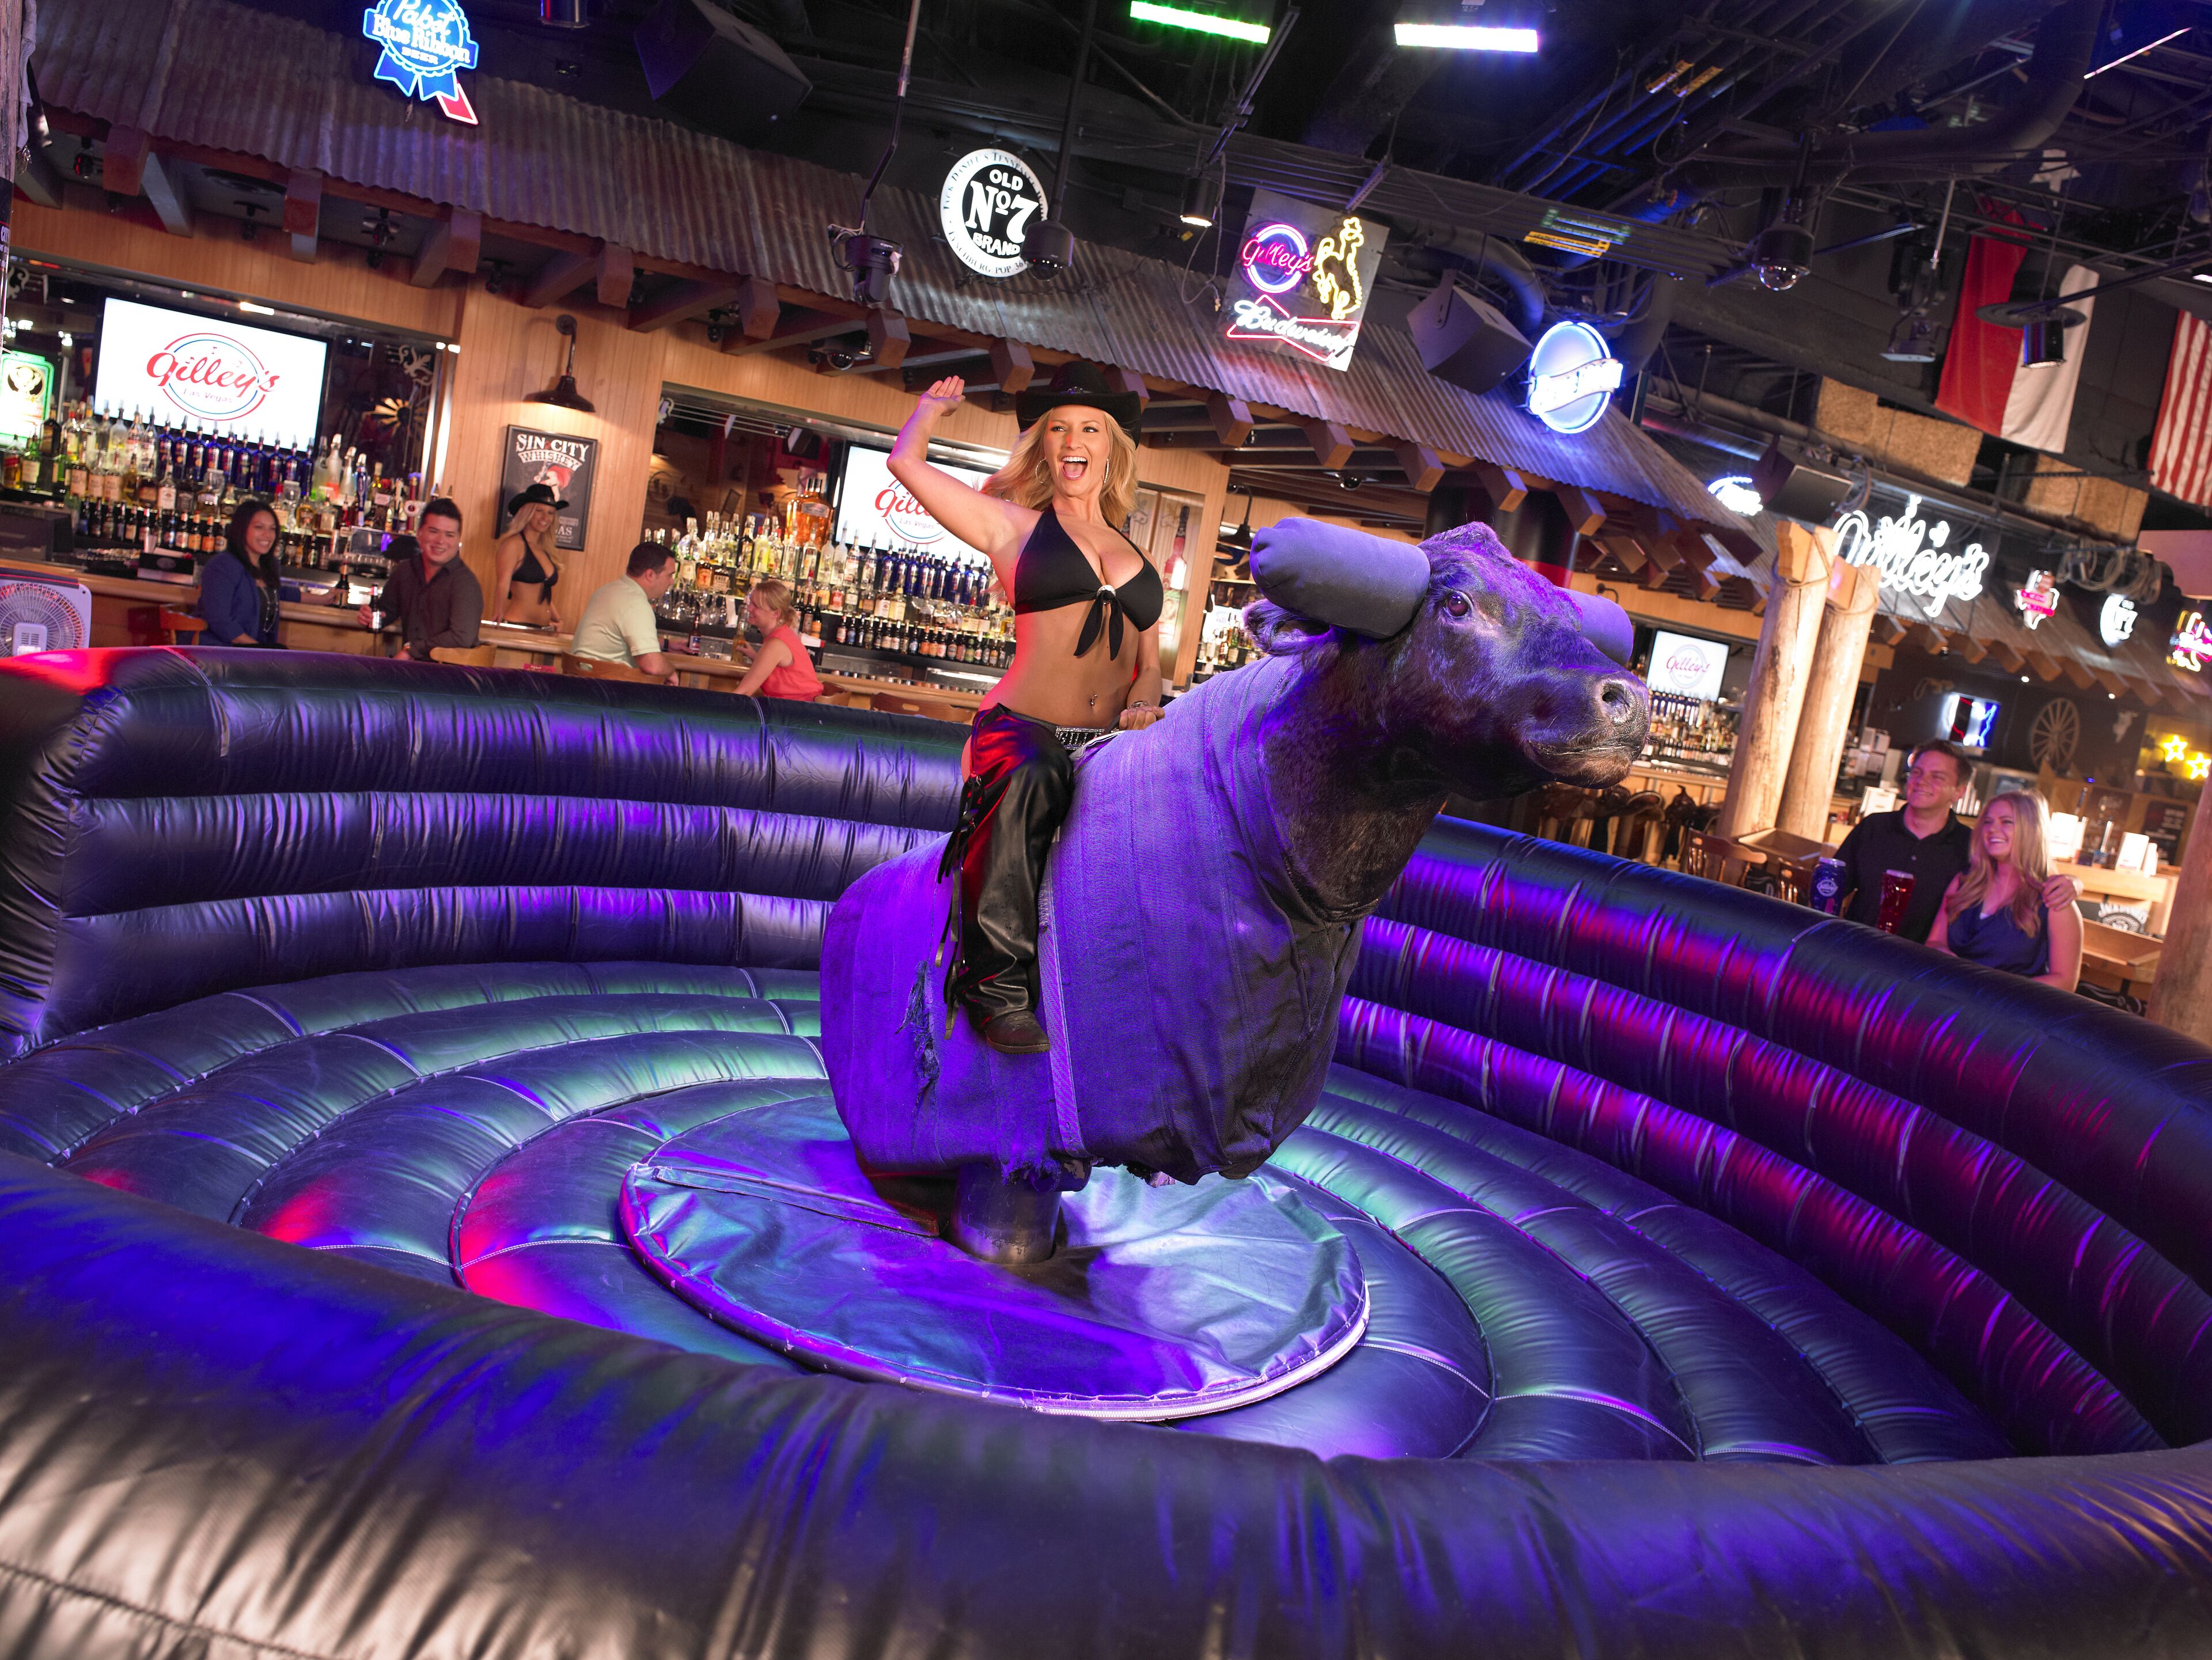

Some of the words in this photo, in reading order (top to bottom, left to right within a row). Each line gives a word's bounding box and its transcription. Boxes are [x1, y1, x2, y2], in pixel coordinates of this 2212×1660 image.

[392, 0, 456, 35] Pabst
[372, 13, 411, 44] Blue
[411, 26, 471, 63] Ribbon
[989, 169, 1024, 191] OLD
[972, 232, 1021, 256] BRAND
[146, 352, 280, 398] Gilley's
[516, 433, 546, 453] SIN
[550, 439, 589, 463] CITY
[521, 451, 579, 470] WHISKEY
